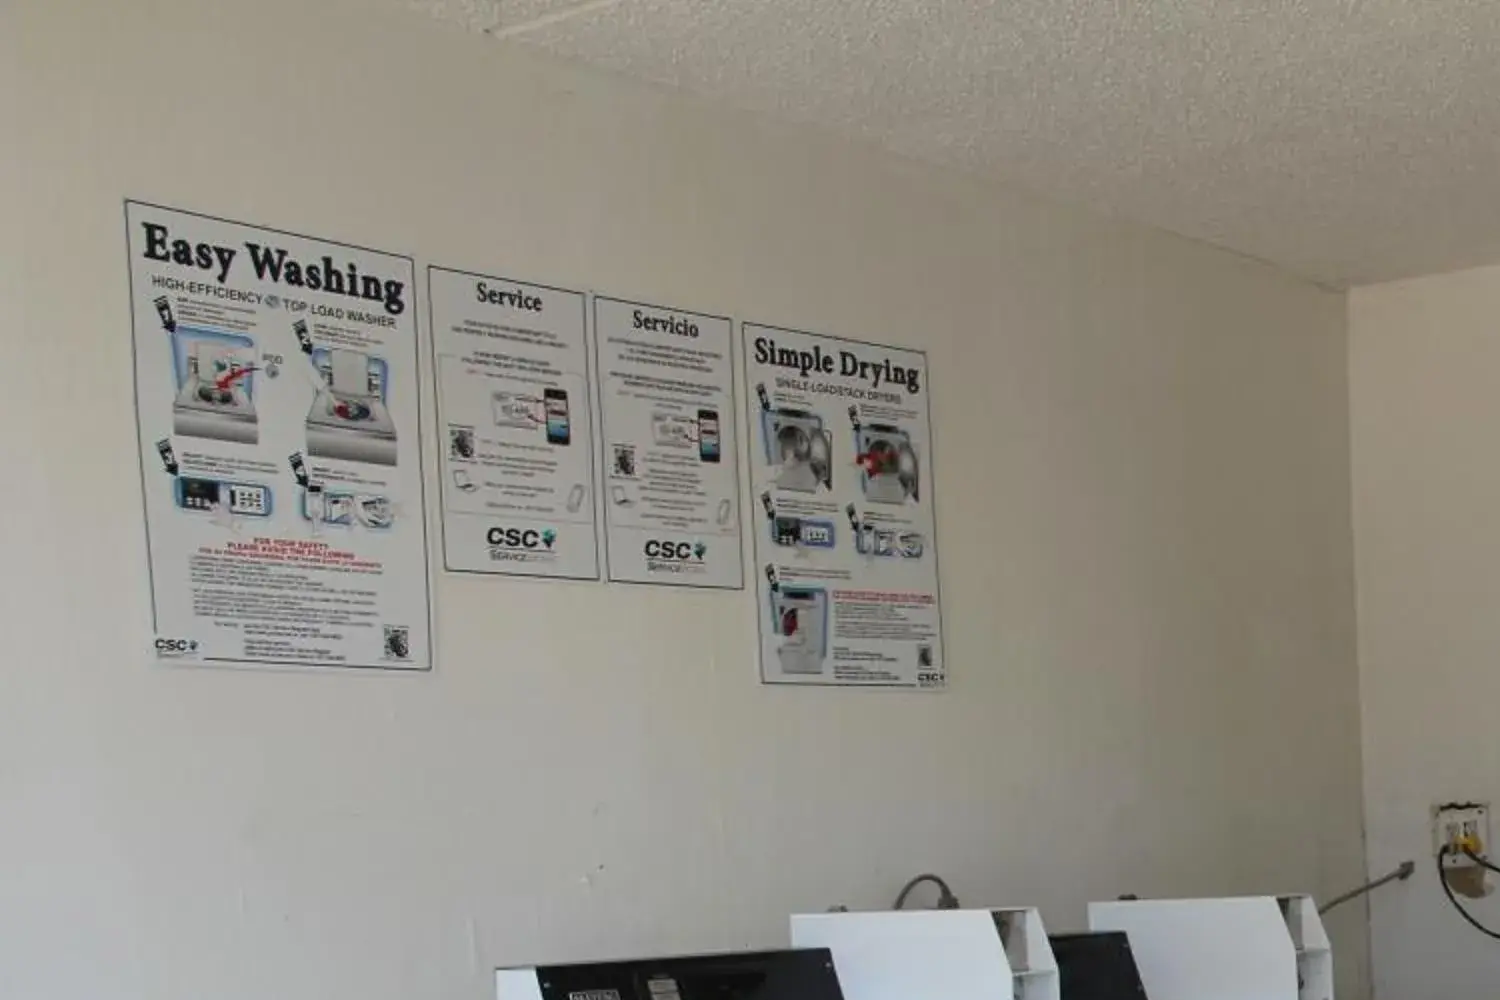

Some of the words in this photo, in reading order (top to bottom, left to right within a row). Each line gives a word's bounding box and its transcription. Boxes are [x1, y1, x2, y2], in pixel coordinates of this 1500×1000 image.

[141, 222, 237, 283] Easy
[245, 241, 406, 315] Washing
[475, 282, 543, 312] Service
[282, 298, 307, 313] TOP
[311, 304, 345, 321] LOAD
[346, 310, 398, 329] WASHER
[632, 310, 700, 339] Servicio
[754, 337, 835, 377] Simple
[839, 350, 920, 394] Drying
[487, 527, 540, 548] CSC
[644, 539, 692, 560] CSC
[155, 638, 188, 651] CSC
